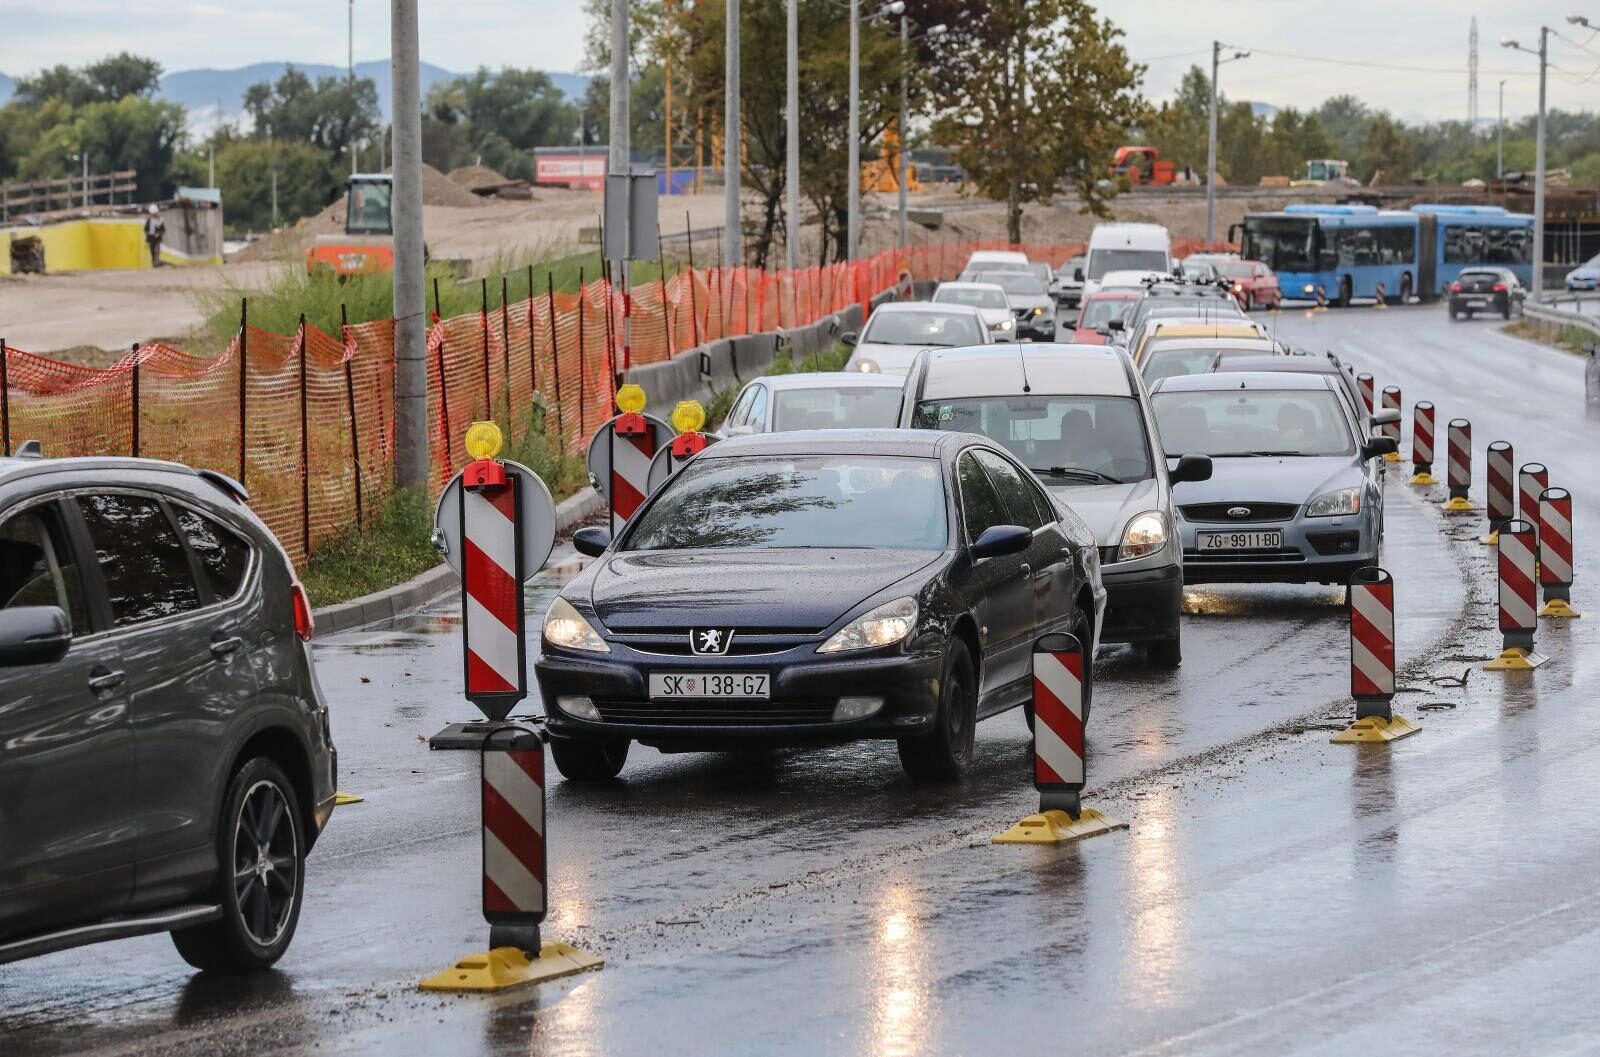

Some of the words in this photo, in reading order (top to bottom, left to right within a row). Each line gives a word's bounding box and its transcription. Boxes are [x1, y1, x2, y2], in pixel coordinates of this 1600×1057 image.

[1207, 534, 1222, 548] ZG
[663, 675, 684, 695] SK
[701, 675, 766, 695] 138-GZ
